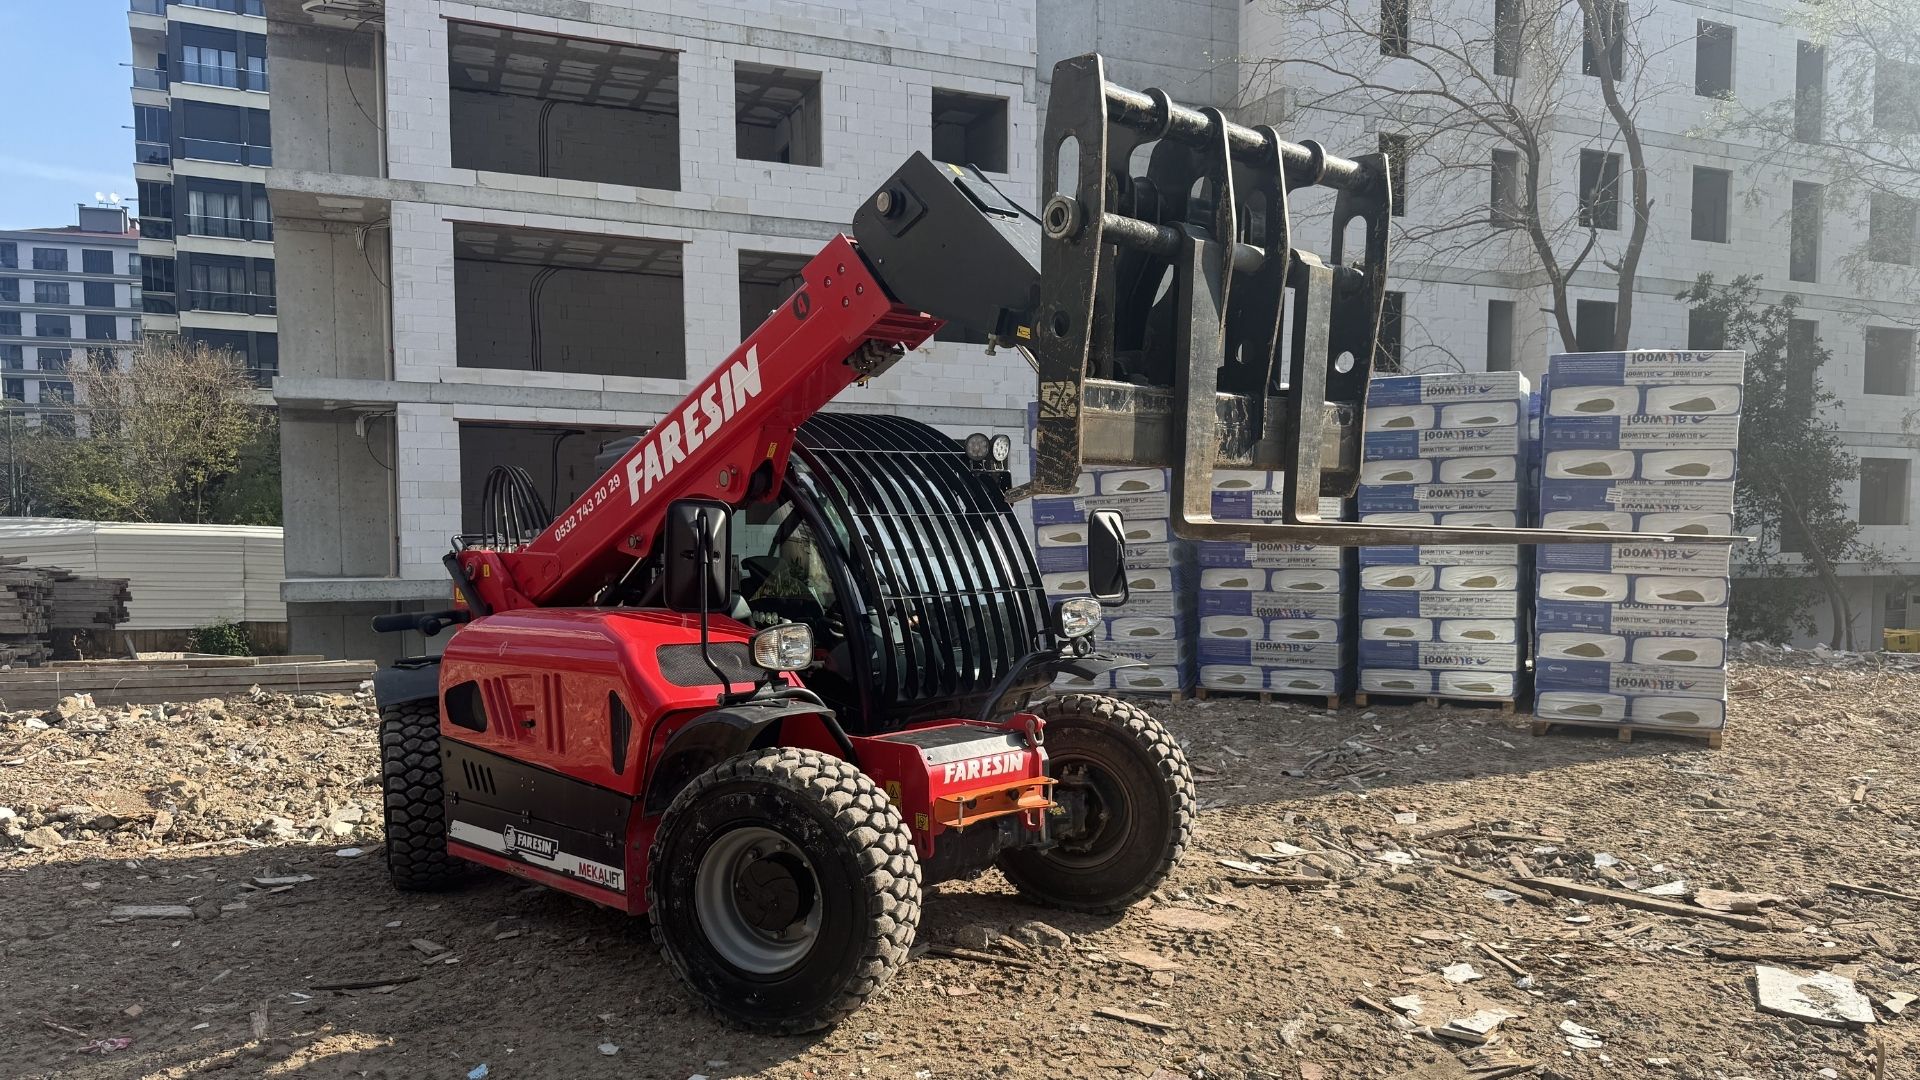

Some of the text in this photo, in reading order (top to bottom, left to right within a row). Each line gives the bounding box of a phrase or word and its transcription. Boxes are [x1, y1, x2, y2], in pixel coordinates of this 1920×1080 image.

[1632, 352, 1692, 364] allwool
[1426, 385, 1476, 397] allwool
[626, 343, 762, 507] FARESIN
[1627, 415, 1687, 426] allwool
[1425, 430, 1474, 441] allwool
[554, 474, 621, 542] 0532 743 20 29
[1257, 543, 1300, 552] allwool
[1618, 549, 1677, 560] allwool
[1255, 642, 1300, 653] allwool
[1423, 655, 1473, 666] allwool
[1616, 677, 1674, 691] allwool
[943, 753, 1024, 784] FARESIN
[517, 833, 552, 854] FARESIN
[578, 862, 621, 885] MEKALIFT
